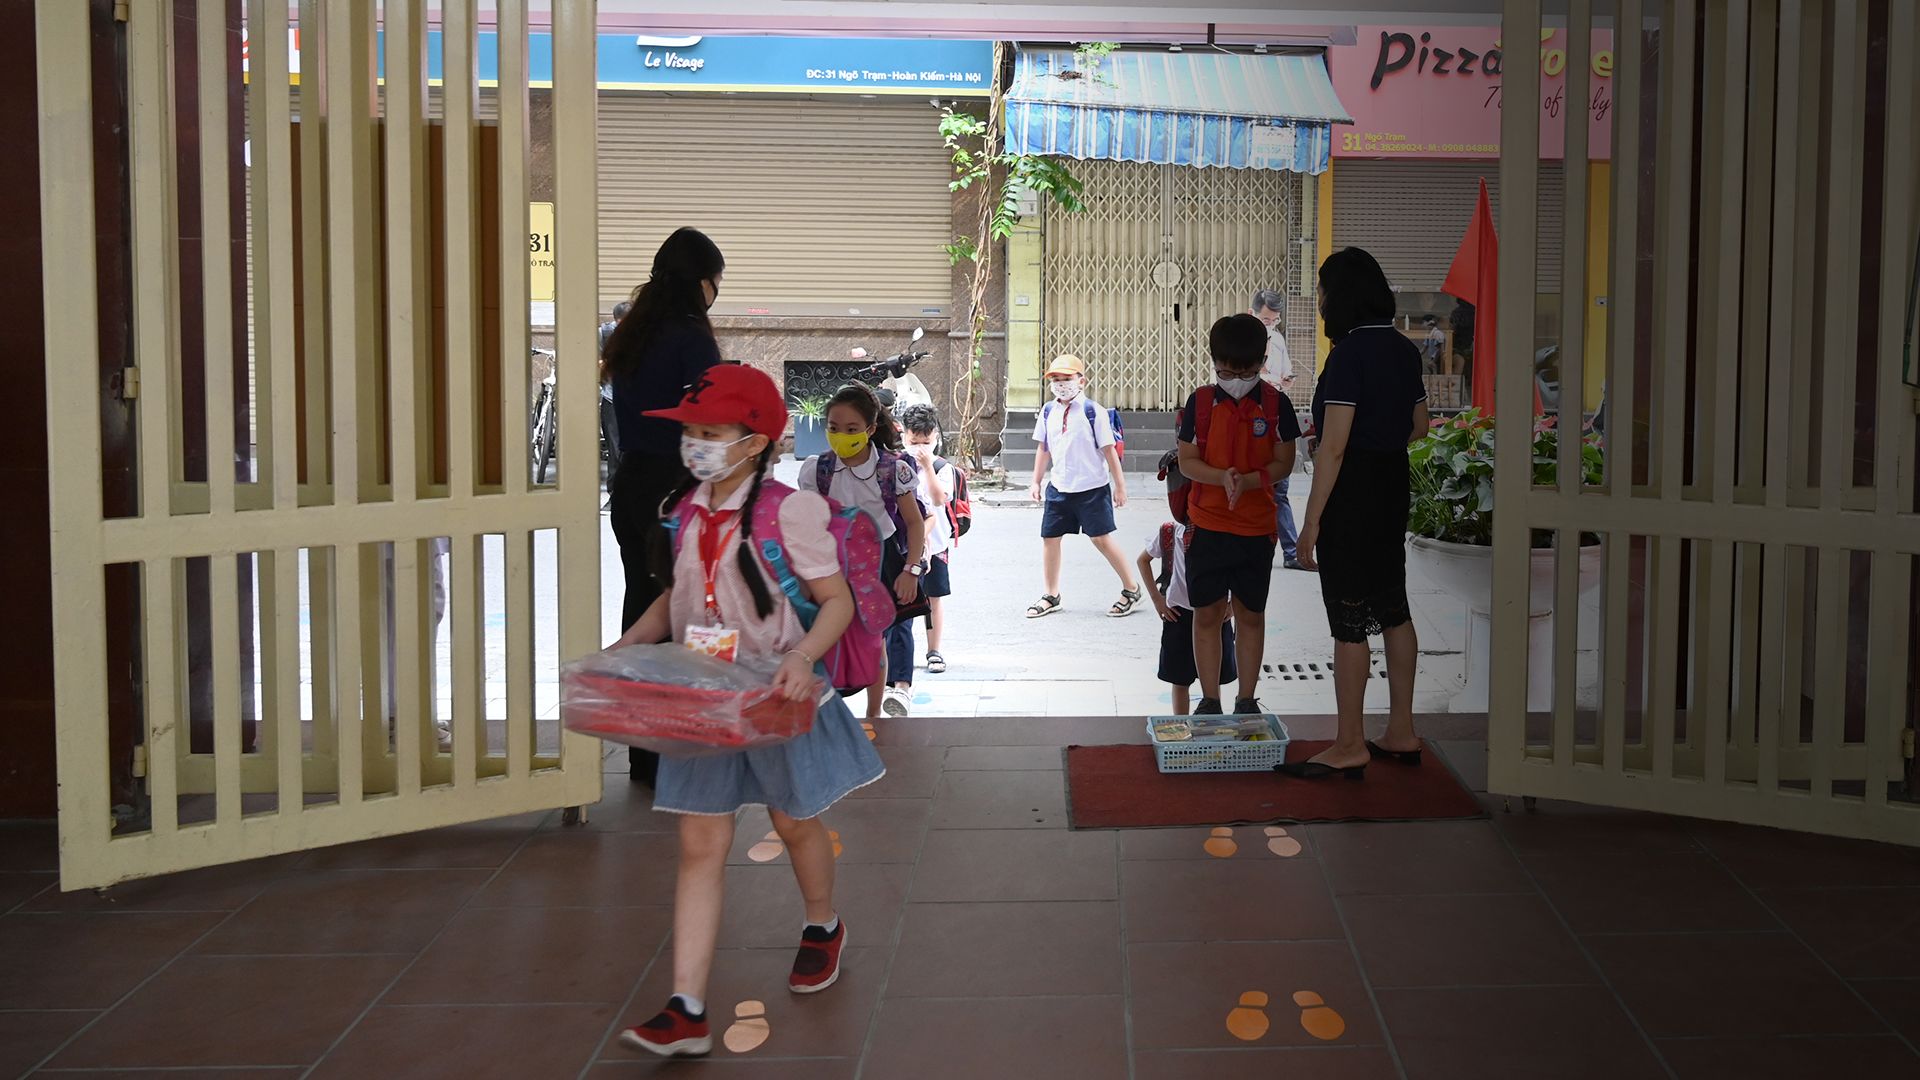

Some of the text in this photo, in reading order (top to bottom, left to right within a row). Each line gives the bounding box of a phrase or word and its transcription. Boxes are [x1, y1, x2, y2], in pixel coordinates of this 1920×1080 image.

[644, 51, 704, 72] Le Visage
[1370, 31, 1502, 90] Pizza
[838, 70, 859, 81] Ngõ
[965, 71, 982, 83] Nội
[1342, 133, 1361, 151] 31
[530, 233, 550, 252] 31
